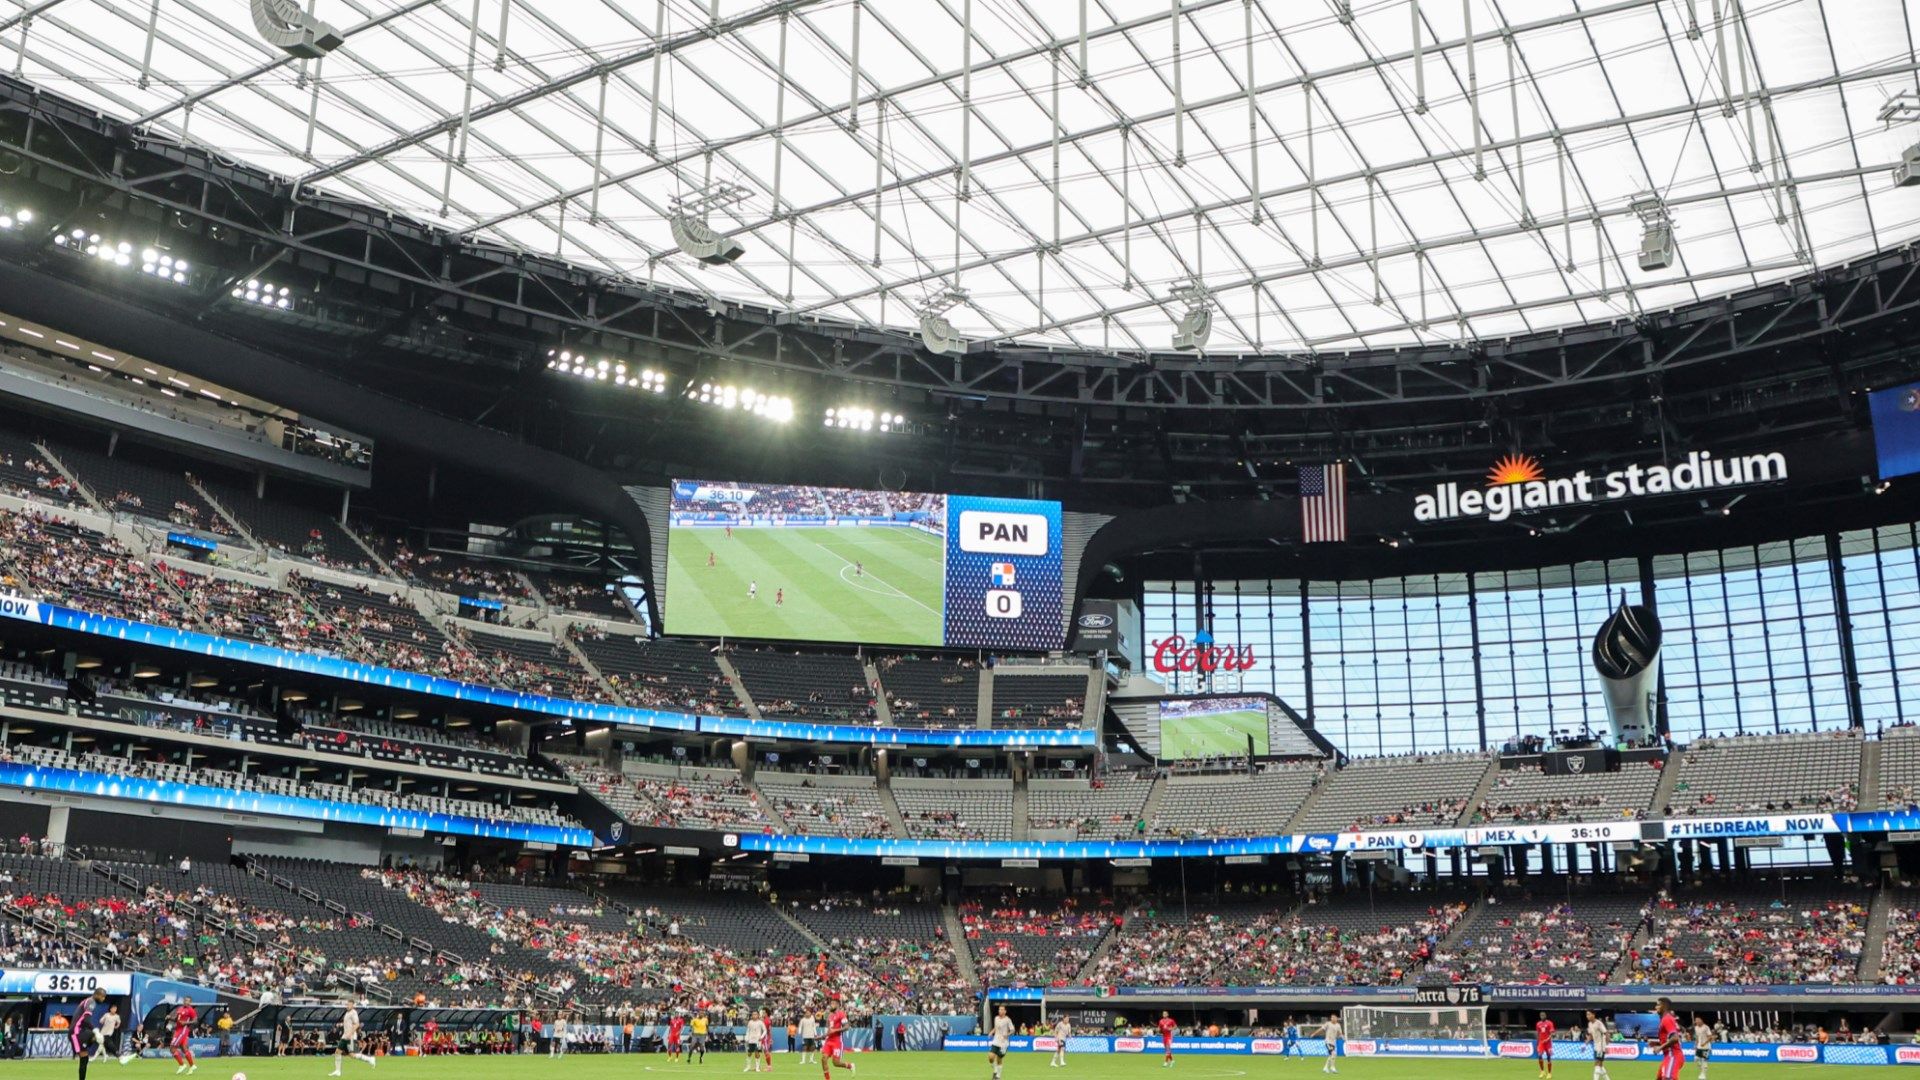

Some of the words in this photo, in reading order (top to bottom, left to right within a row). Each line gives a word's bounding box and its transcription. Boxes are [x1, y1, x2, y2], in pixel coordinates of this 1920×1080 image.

[1413, 470, 1592, 522] allegiant
[1605, 451, 1788, 499] stadium
[709, 490, 744, 502] 36:10
[979, 522, 1029, 542] PAN
[0, 599, 29, 616] OW
[997, 595, 1011, 613] 0
[1084, 616, 1107, 626] Ford
[1151, 635, 1258, 673] Coors
[1670, 820, 1770, 835] #THEDREAM
[1785, 818, 1825, 830] NOW
[1485, 830, 1517, 842] MEX
[1532, 829, 1538, 839] 1
[1571, 827, 1612, 839] 36:10
[1368, 836, 1395, 847] PAN
[1409, 834, 1417, 844] 0
[48, 975, 98, 991] 36:10
[1461, 987, 1479, 1003] 76
[1492, 988, 1540, 997] AMERICAN
[1549, 988, 1586, 998] OUTLAWS
[1117, 1041, 1142, 1049] BIMBO
[1201, 1041, 1225, 1049] mundo
[1225, 1041, 1246, 1051] mejor
[1254, 1042, 1281, 1050] BIMBO
[1347, 1043, 1374, 1051] BIMBO
[1441, 1044, 1467, 1052] mundo
[1500, 1045, 1530, 1053] BIMBO
[1711, 1047, 1742, 1056] mundo
[1743, 1048, 1770, 1058] mejor
[1780, 1049, 1815, 1058] BIMBO
